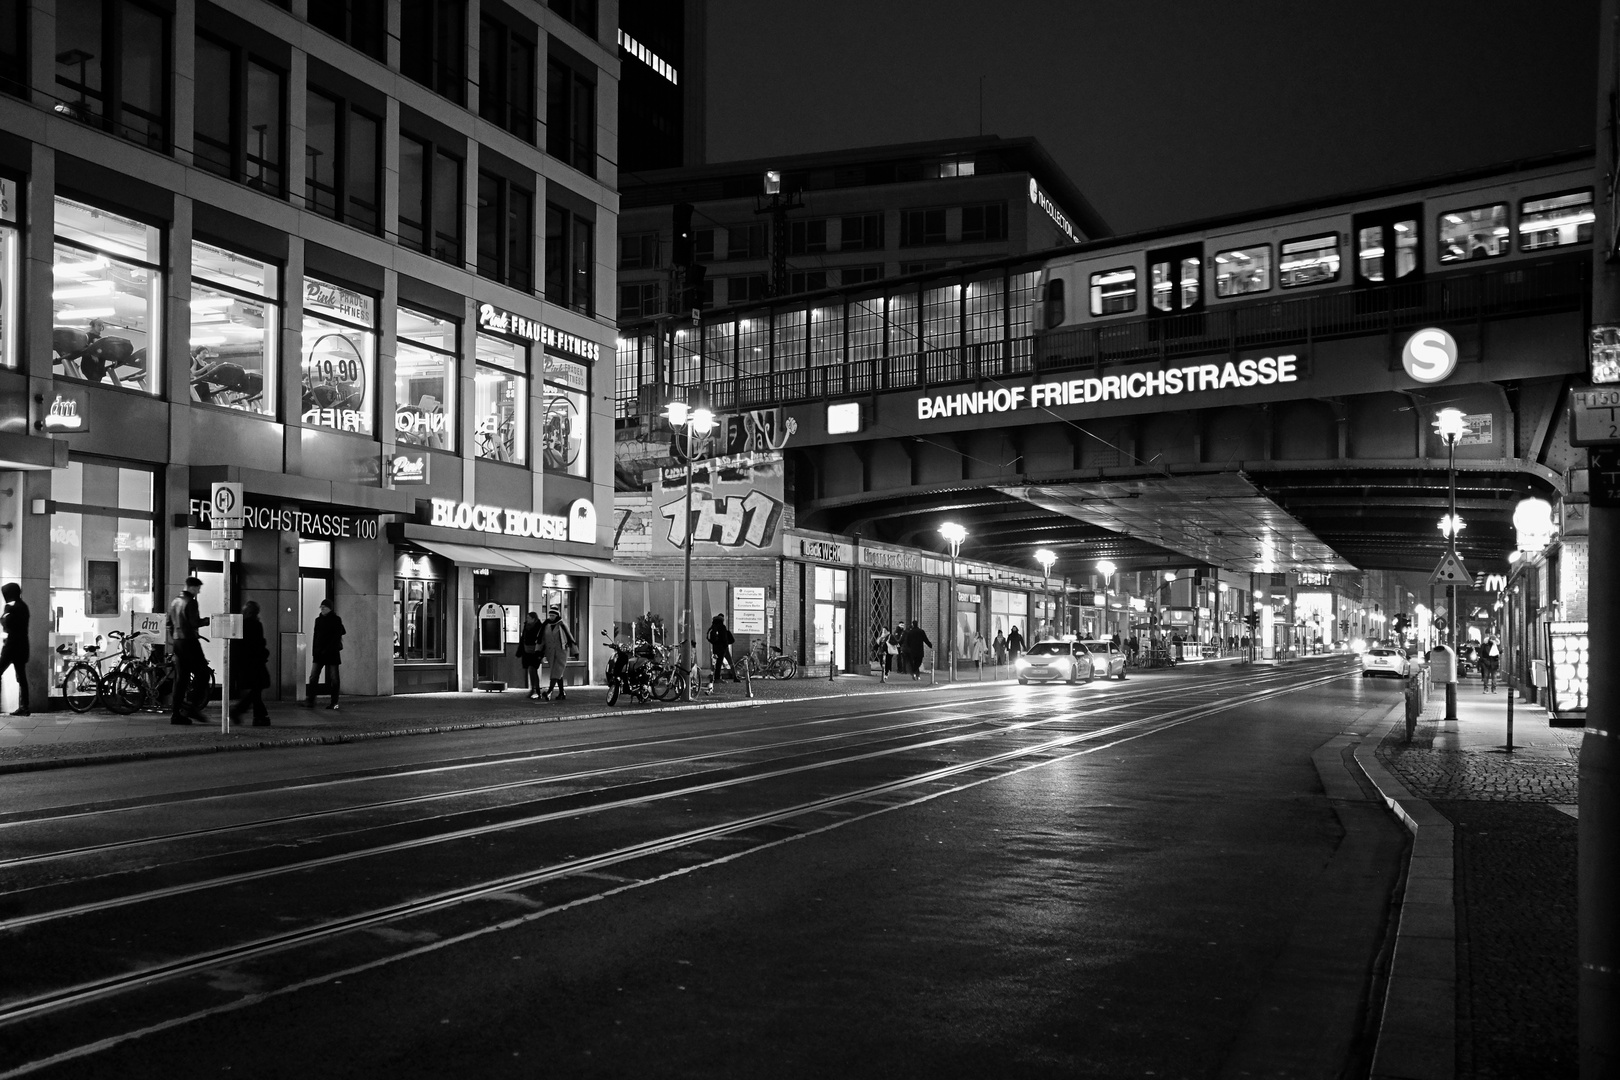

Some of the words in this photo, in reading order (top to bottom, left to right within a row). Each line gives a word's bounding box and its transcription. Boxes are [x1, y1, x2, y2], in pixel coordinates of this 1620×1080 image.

[1045, 199, 1073, 238] COLLECTION
[306, 282, 337, 305] Pink
[339, 304, 370, 321] FITNESS
[479, 303, 509, 330] Pink
[511, 315, 556, 347] FRAUEN
[557, 331, 600, 362] FITNESS
[1410, 331, 1450, 380] S
[917, 386, 1026, 420] BAHNHOF
[1030, 354, 1298, 408] FRIEDRICHSTRASSE
[50, 395, 77, 418] dm
[392, 456, 424, 474] Pink
[355, 518, 377, 540] 100
[430, 497, 503, 534] BLOCK
[504, 508, 567, 541] HOUSE
[142, 616, 158, 630] dm
